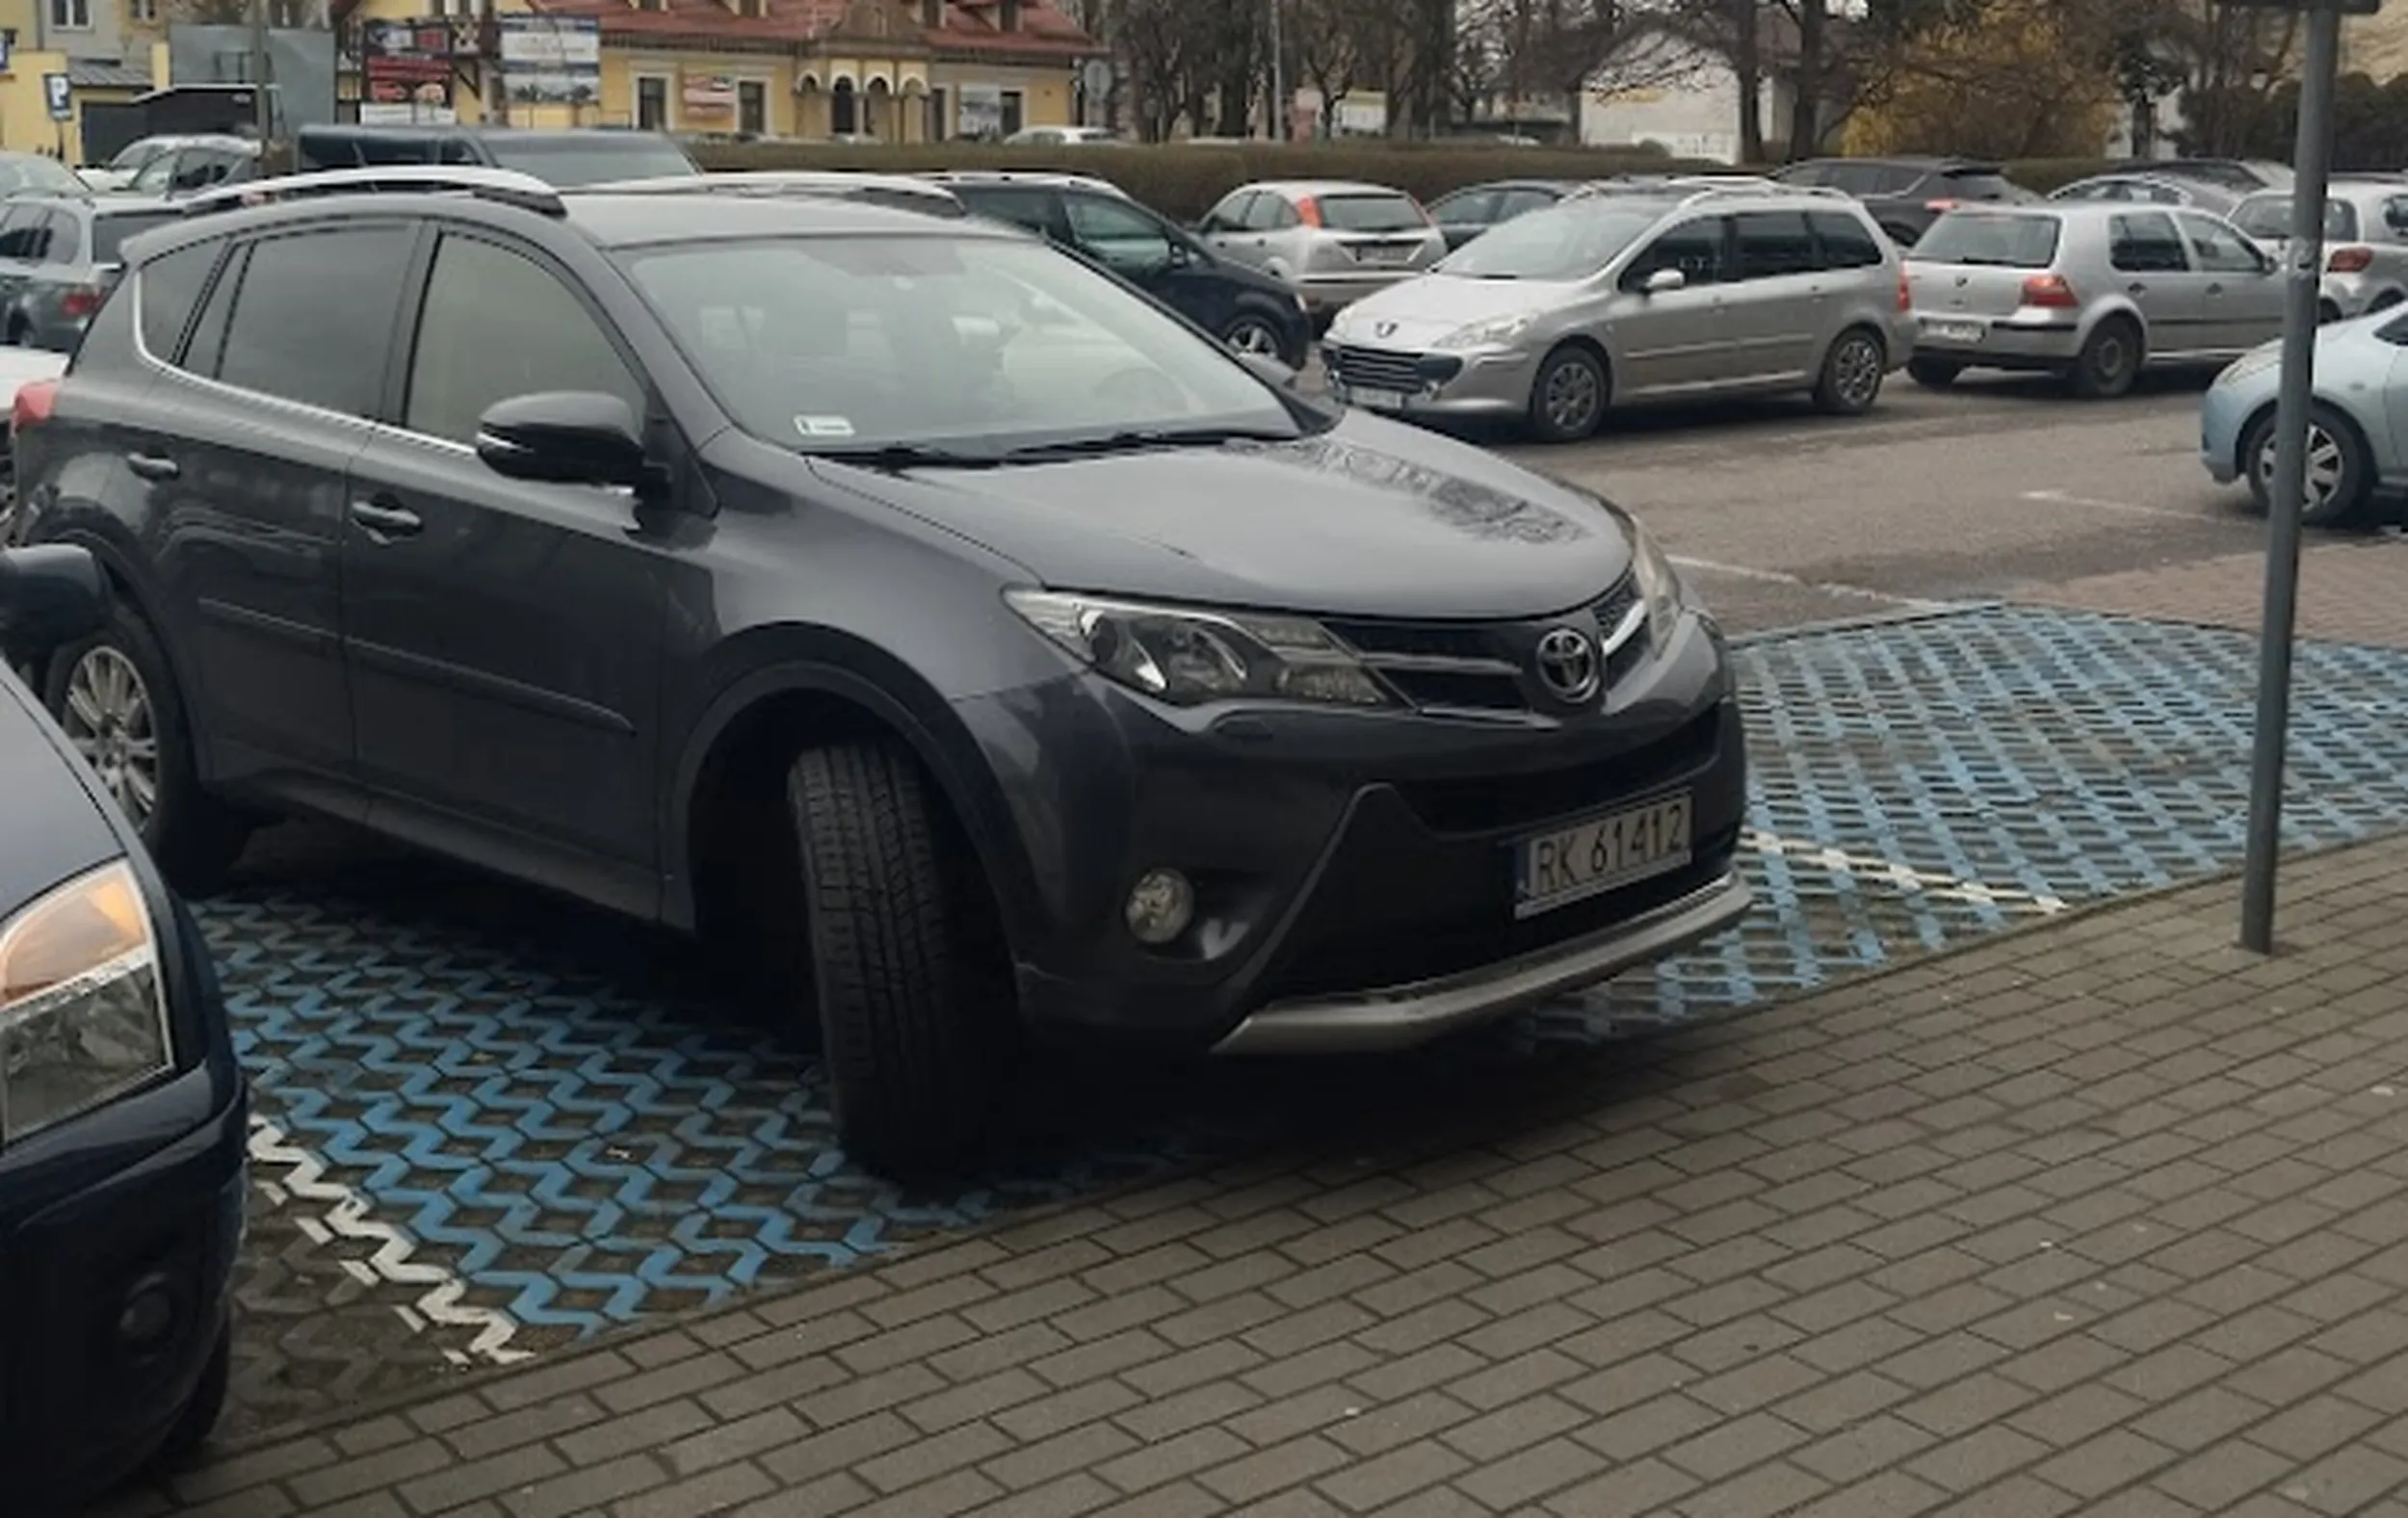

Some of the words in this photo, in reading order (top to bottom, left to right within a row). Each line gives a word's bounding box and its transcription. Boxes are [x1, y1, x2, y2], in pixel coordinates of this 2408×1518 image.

[49, 76, 68, 108] P
[1538, 834, 1581, 897] RK
[1591, 803, 1683, 874] 61412
